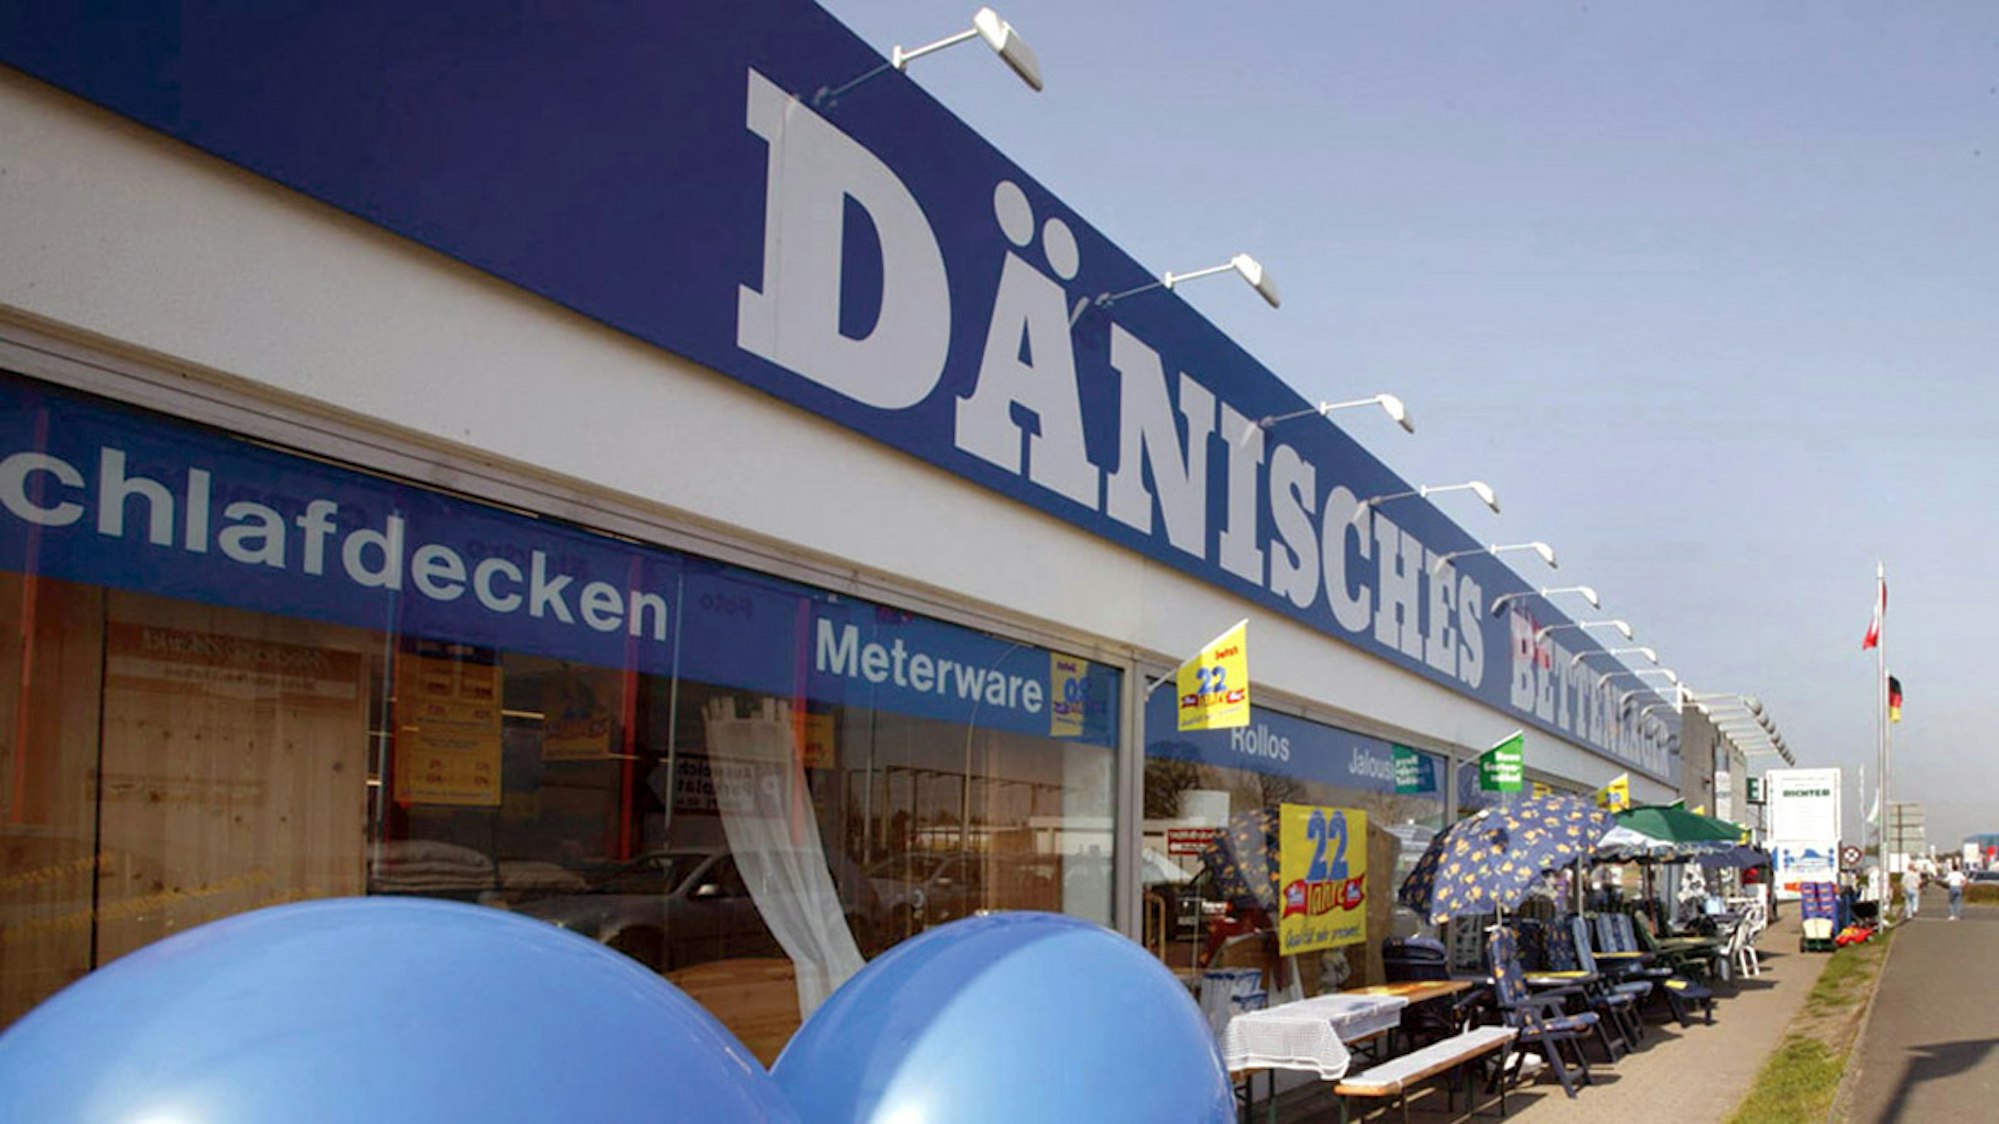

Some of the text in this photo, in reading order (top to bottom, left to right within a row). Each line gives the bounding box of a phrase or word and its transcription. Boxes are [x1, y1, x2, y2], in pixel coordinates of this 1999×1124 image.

[736, 66, 1484, 690] DÄNISCHES
[815, 618, 1044, 714] Meterware
[1195, 665, 1228, 696] 22
[1230, 723, 1290, 763] Rollos
[1305, 809, 1349, 882] 22
